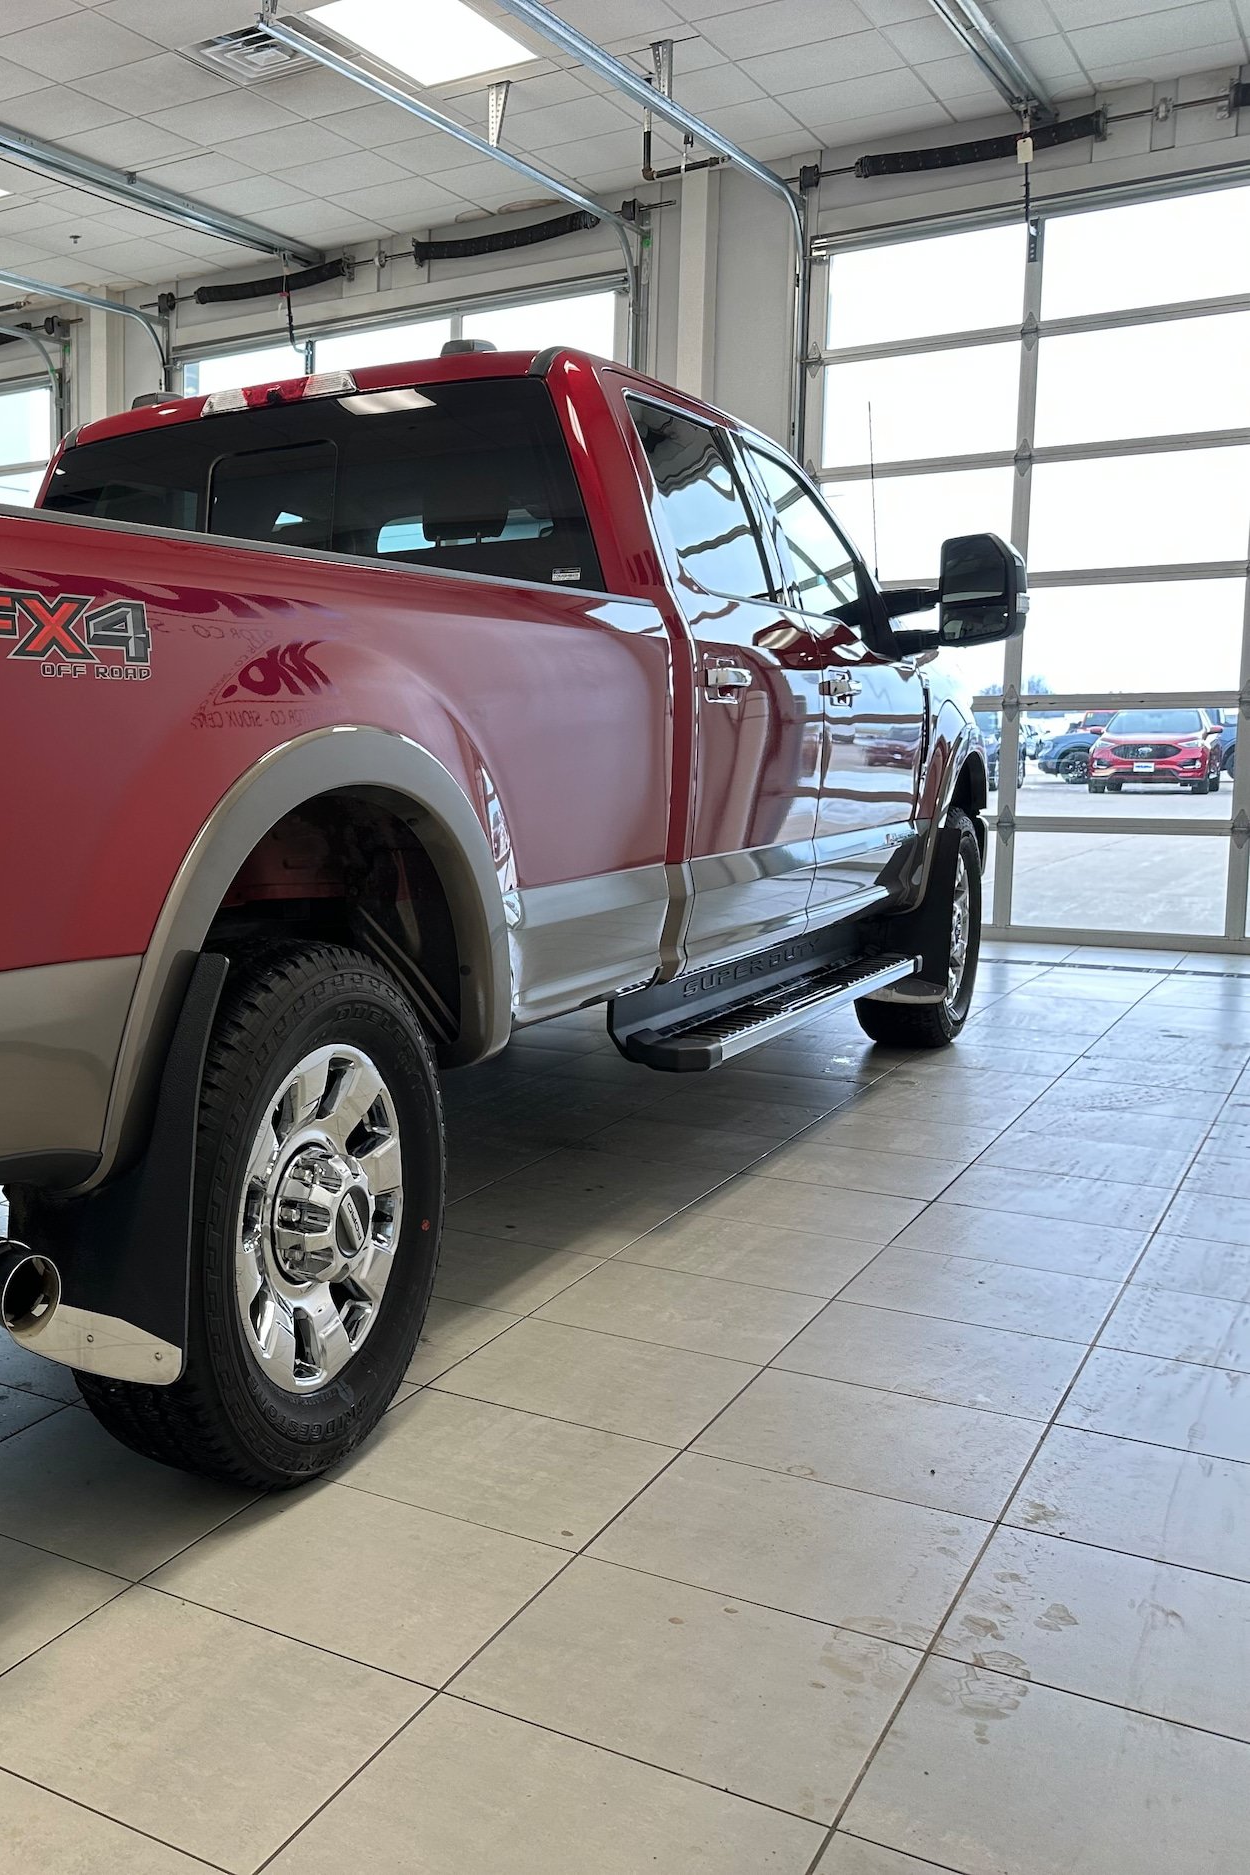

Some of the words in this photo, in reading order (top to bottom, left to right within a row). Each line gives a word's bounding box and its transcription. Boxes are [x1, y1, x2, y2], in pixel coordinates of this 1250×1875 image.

[41, 661, 87, 679] OFF
[94, 664, 151, 681] ROAD
[683, 960, 764, 998] SUPER
[770, 938, 820, 968] DUTY
[248, 1376, 368, 1442] BRIDGESTONE
